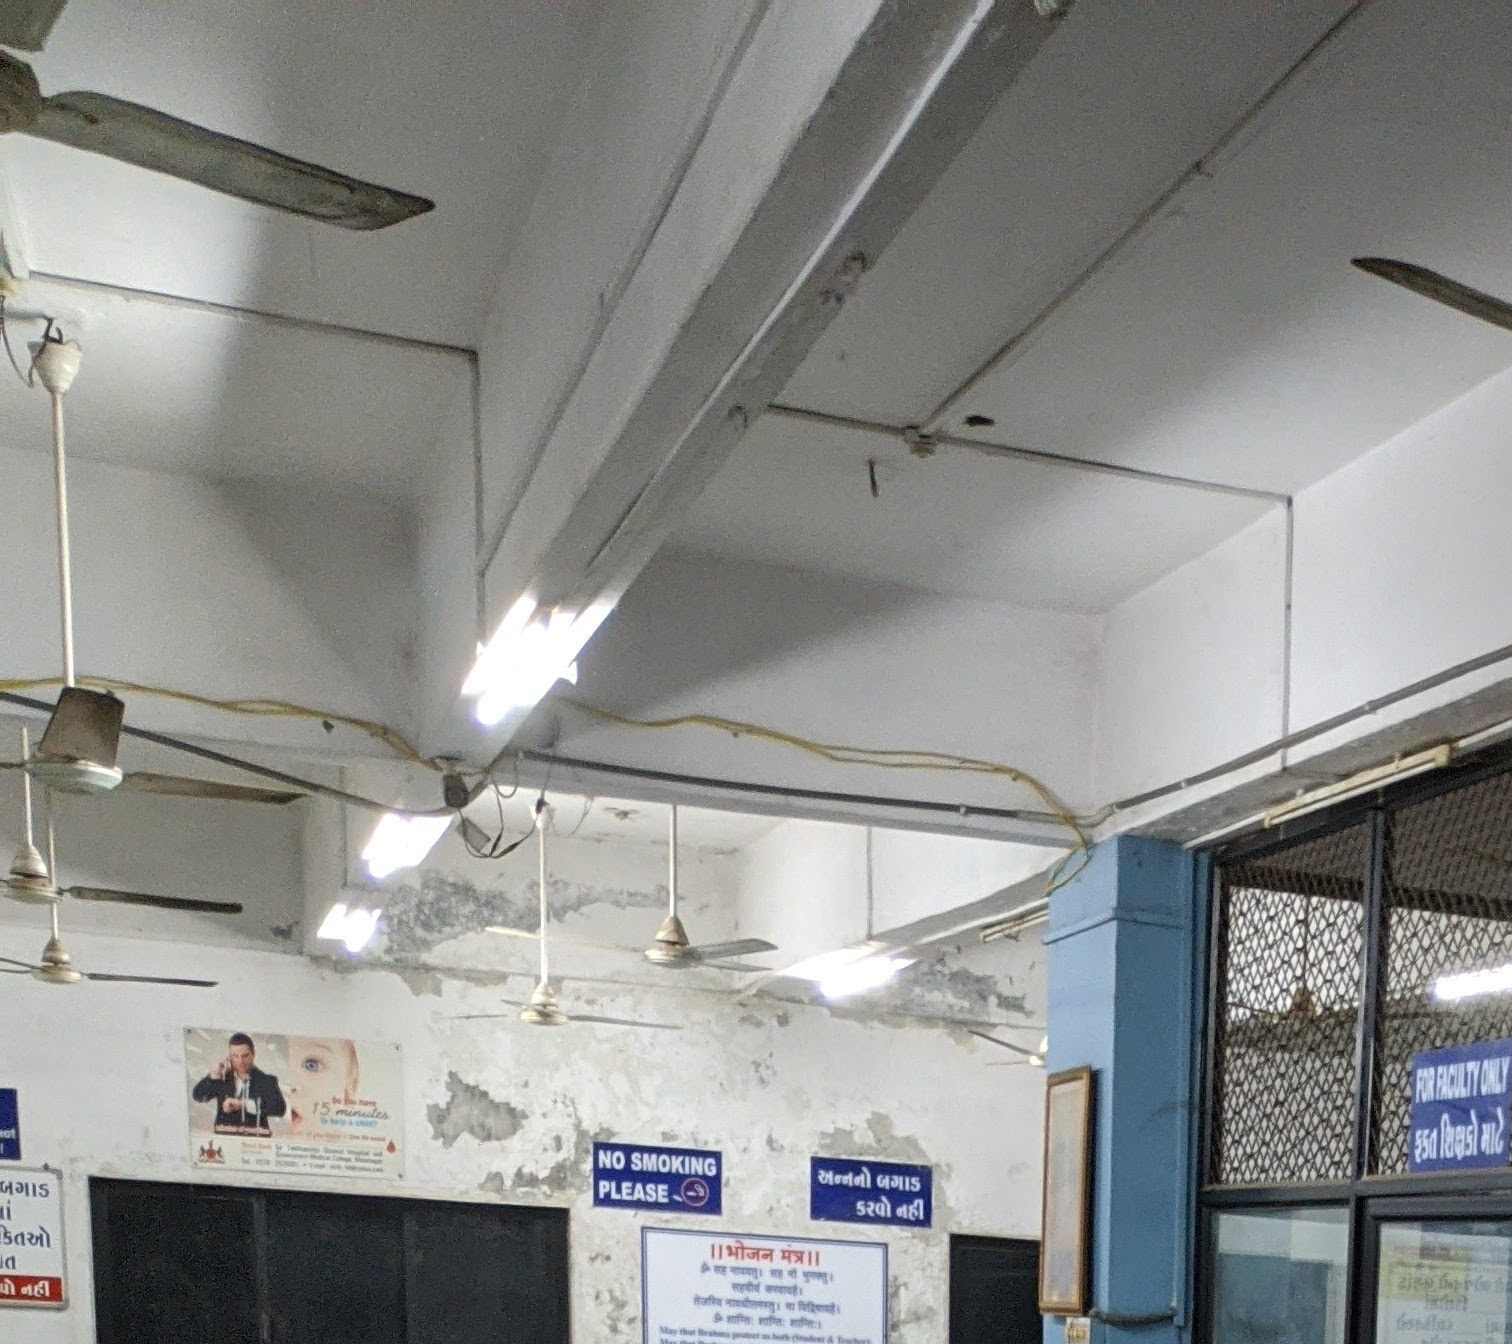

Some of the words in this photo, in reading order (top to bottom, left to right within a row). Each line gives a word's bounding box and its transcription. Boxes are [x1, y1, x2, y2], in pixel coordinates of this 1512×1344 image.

[1416, 1067, 1435, 1103] FOR
[1436, 1060, 1480, 1101] FACULTY
[1481, 1056, 1510, 1095] ONLY
[336, 1105, 390, 1120] minutes
[1481, 1106, 1504, 1155] માટે
[599, 1150, 626, 1171] NO
[630, 1154, 717, 1177] SMOKING
[599, 1180, 670, 1204] PLEASE
[817, 1166, 872, 1190] અન્નનો
[876, 1173, 922, 1193] બગાડ
[855, 1199, 893, 1219] કરવો
